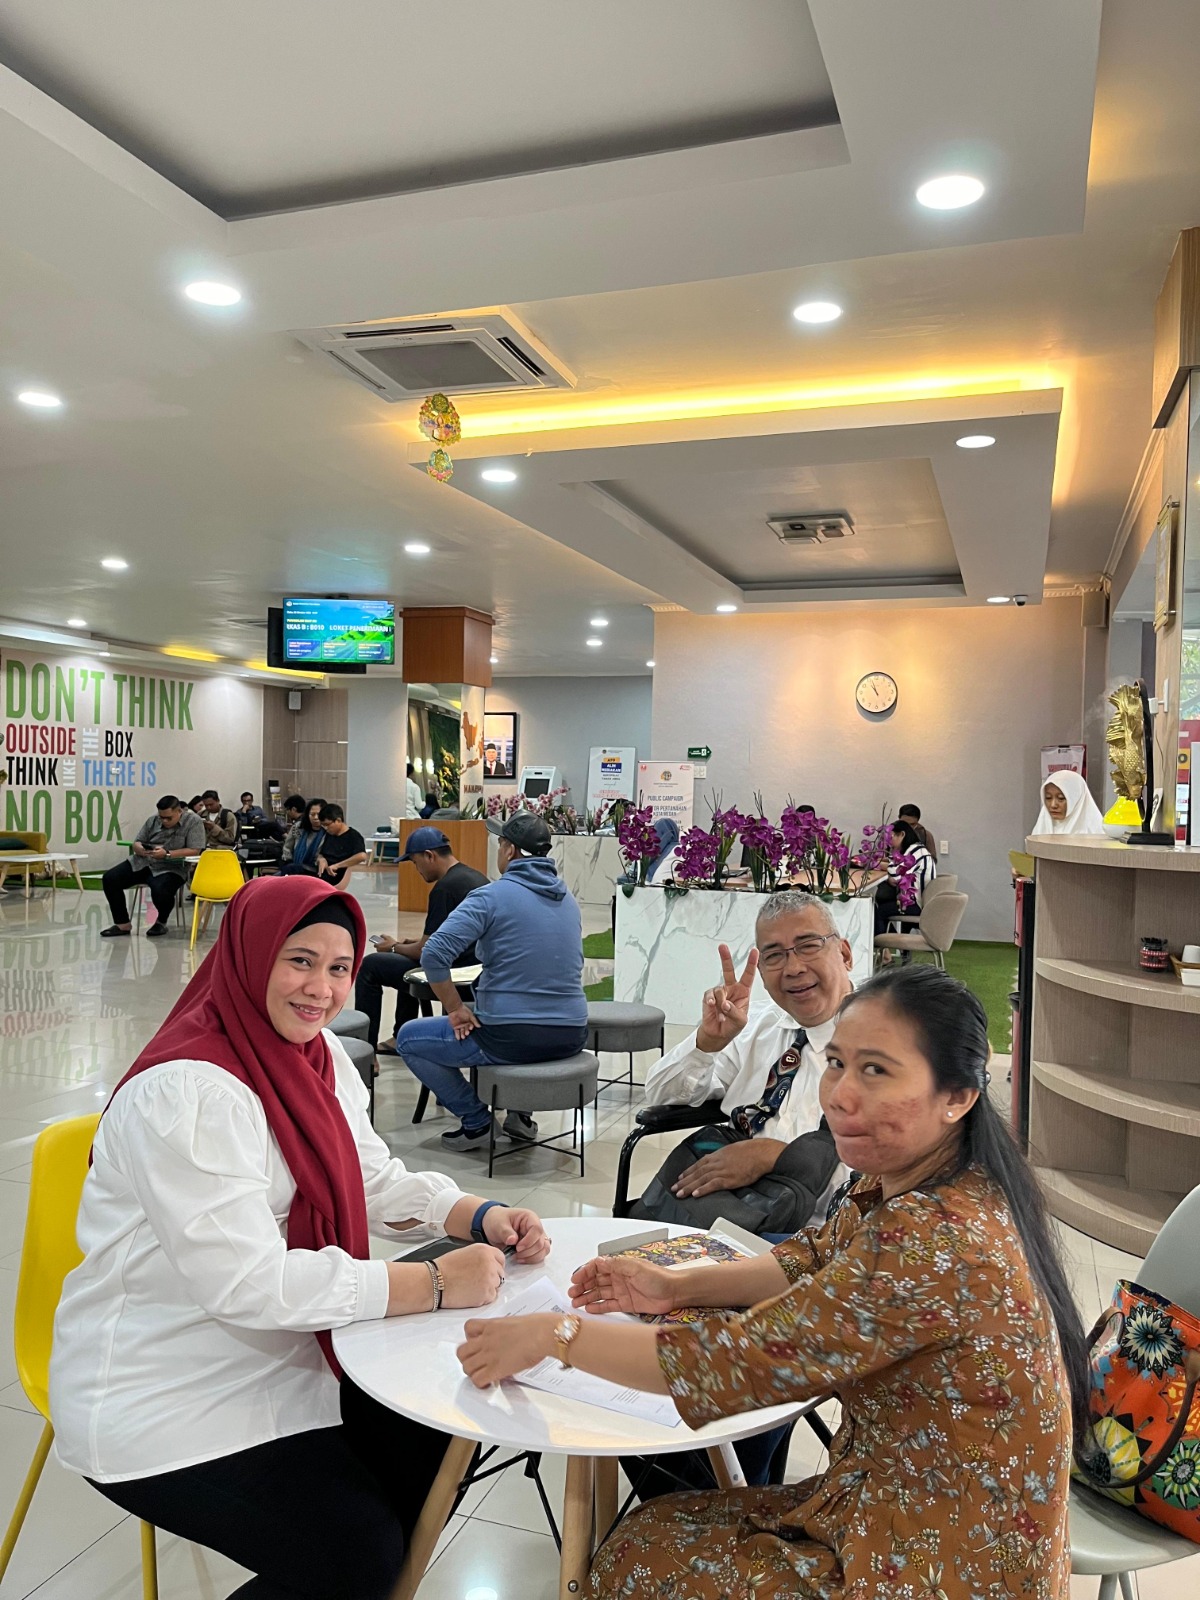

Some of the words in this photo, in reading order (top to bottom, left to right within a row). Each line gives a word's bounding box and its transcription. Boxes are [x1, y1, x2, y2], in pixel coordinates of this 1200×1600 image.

[6, 659, 105, 725] DON'T
[113, 673, 194, 731] THINK
[6, 723, 76, 756] OUTSIDE
[82, 728, 99, 759] THE
[105, 730, 133, 758] BOX
[6, 756, 59, 786] THINK
[63, 758, 76, 788] LIKE
[82, 759, 136, 787] THERE
[141, 761, 157, 787] IS
[6, 789, 52, 843] NO
[65, 789, 123, 844] BOX
